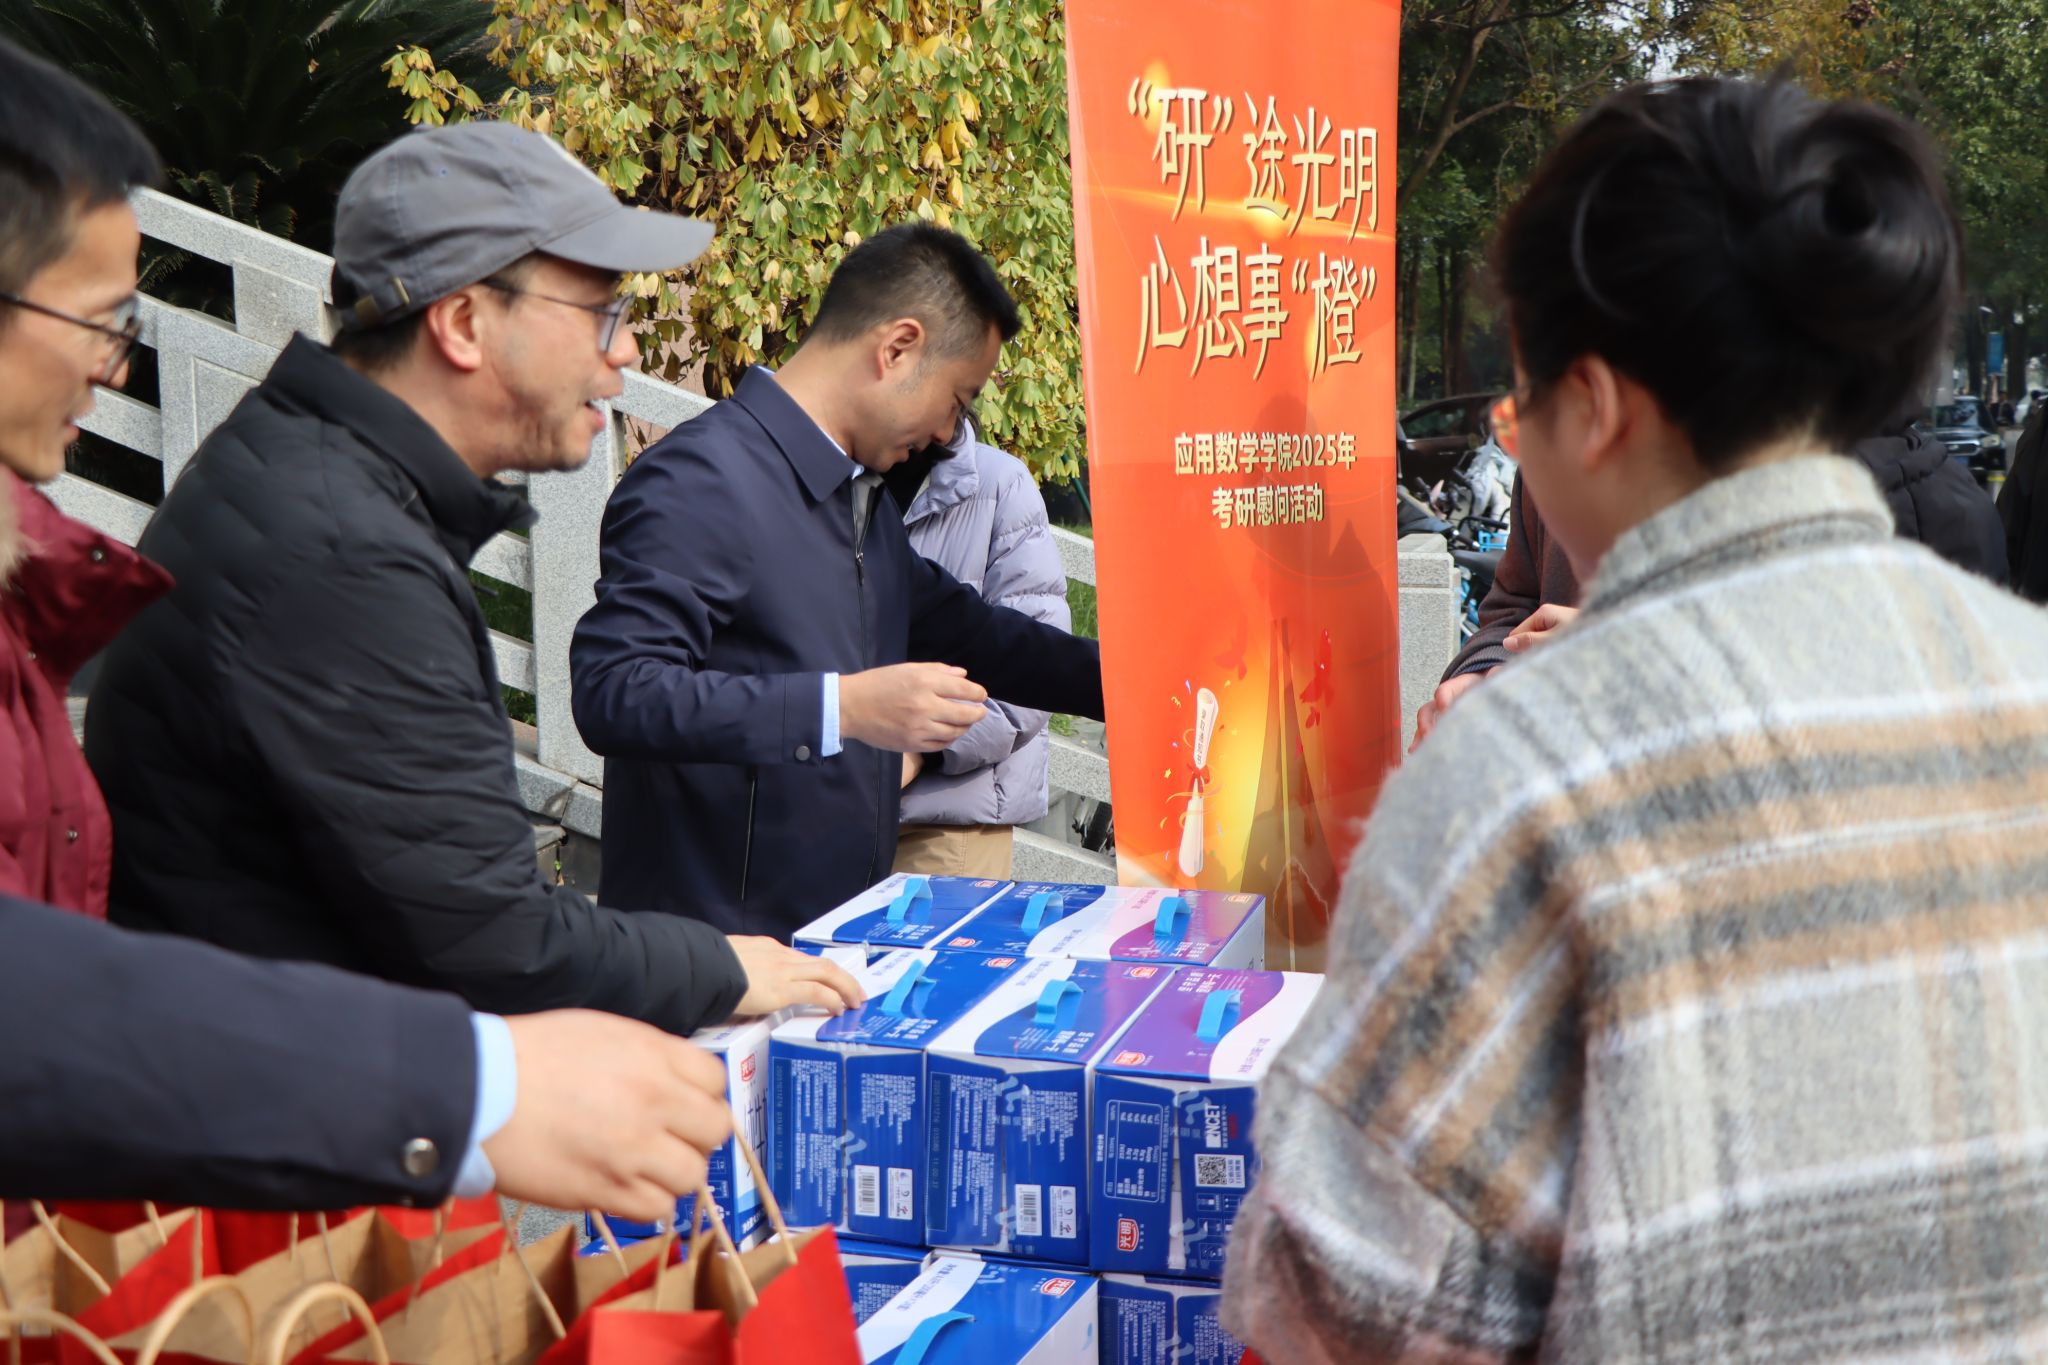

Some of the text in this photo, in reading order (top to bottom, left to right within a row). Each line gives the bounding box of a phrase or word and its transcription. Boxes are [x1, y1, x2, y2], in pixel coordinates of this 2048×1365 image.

[1127, 77, 1378, 245] “研”途光明
[1134, 234, 1377, 381] 心想事“橙”
[1174, 431, 1357, 477] 应用数学学院2025年
[1211, 485, 1325, 530] 考研慰问活动
[1120, 1221, 1132, 1249] 光明
